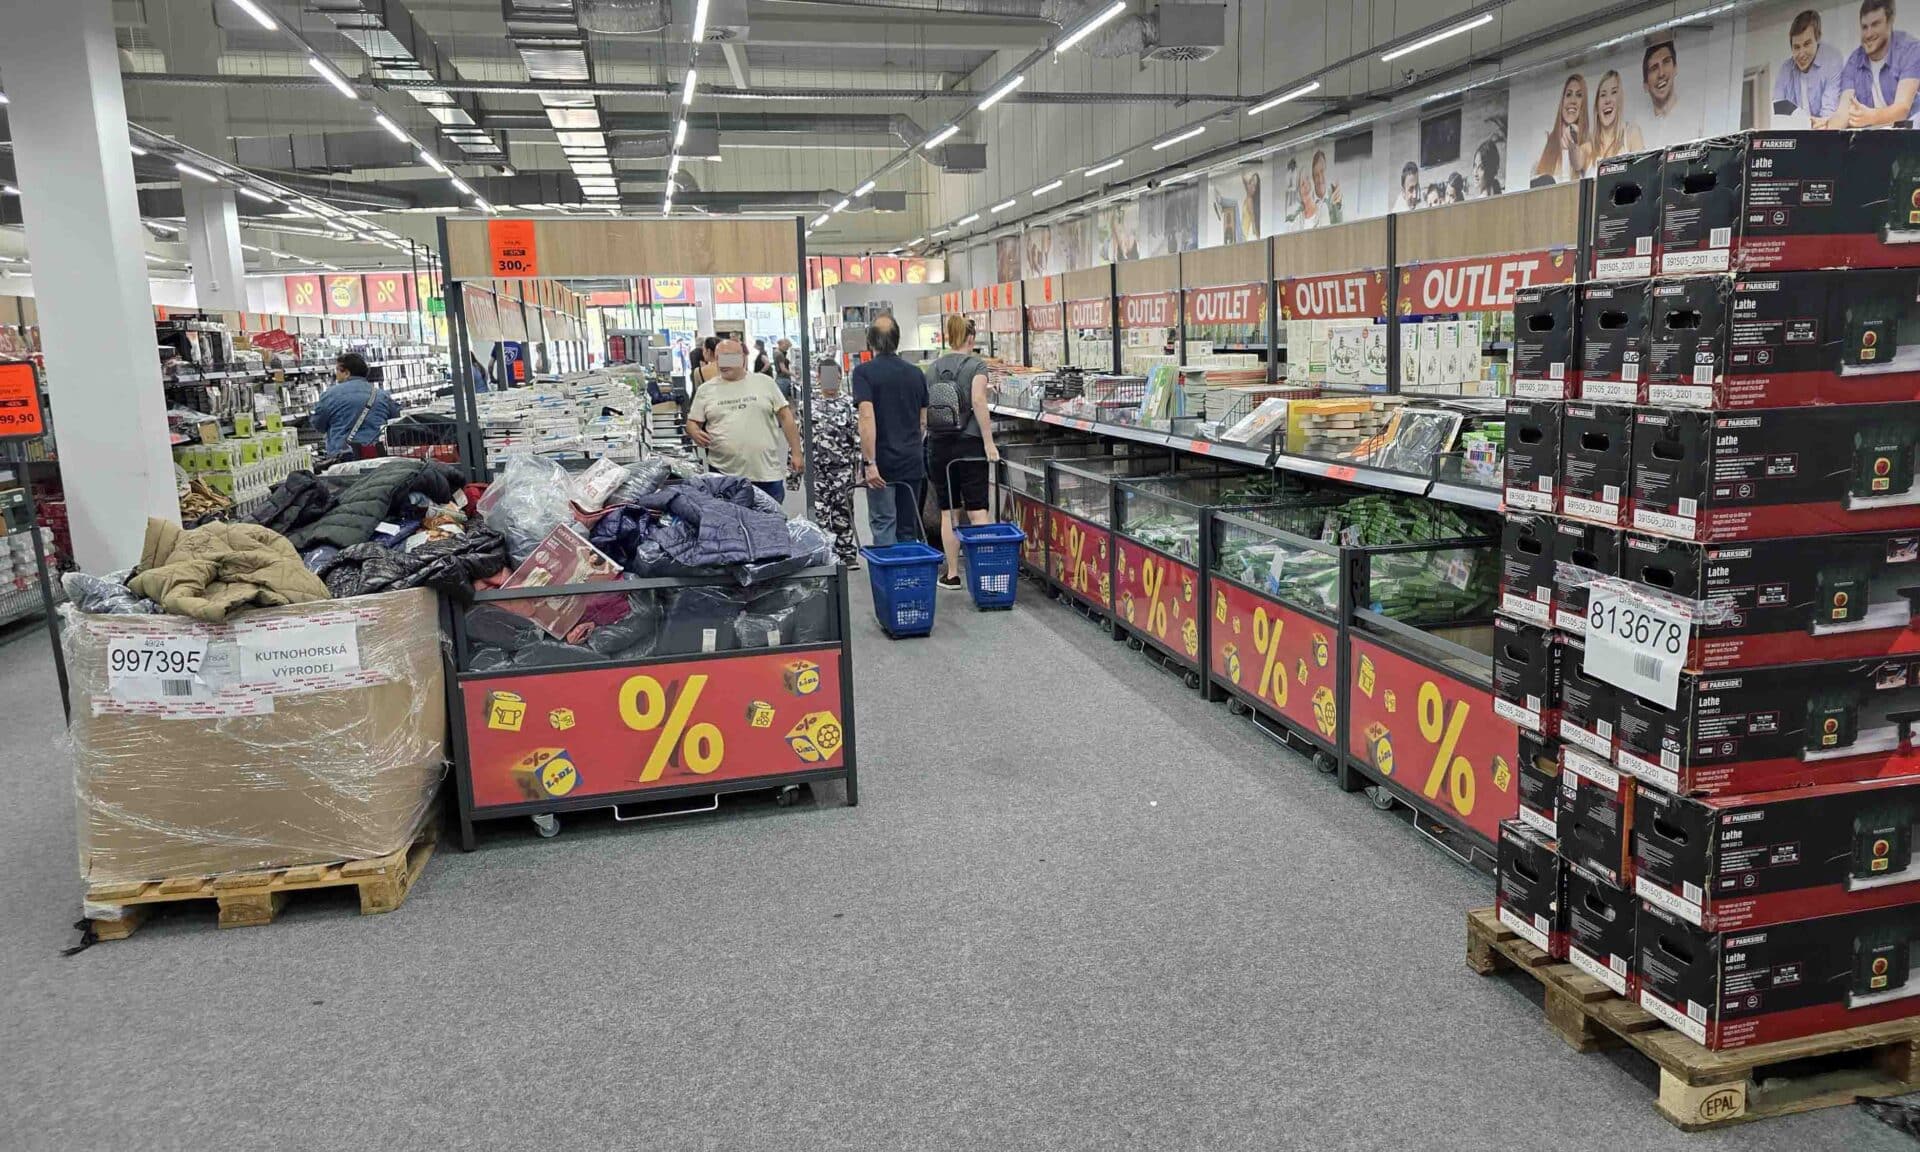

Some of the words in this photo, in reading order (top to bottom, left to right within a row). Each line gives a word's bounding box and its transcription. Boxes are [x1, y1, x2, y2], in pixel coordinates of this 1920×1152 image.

[1762, 140, 1795, 148] PARKSIDE
[1751, 157, 1773, 169] Lathe
[498, 260, 532, 272] 300,-
[1423, 260, 1540, 309] OUTLET
[1745, 282, 1777, 290] PARKSIDE
[1296, 277, 1368, 315] OUTLET
[1127, 297, 1168, 323] OUTLET
[1196, 289, 1250, 321] OUTLET
[1733, 299, 1757, 310] Lathe
[1073, 302, 1104, 327] OUTLET
[1728, 418, 1759, 428] PARKSIDE
[1716, 435, 1738, 447] Lathe
[1718, 550, 1750, 559] PARKSIDE
[1707, 566, 1730, 578] Lathe
[1590, 600, 1682, 654] 813678
[144, 639, 165, 648] 49/24
[255, 644, 348, 662] KUTNOHORSKÁ
[111, 648, 201, 673] 997395
[272, 663, 334, 678] VÝPRODEJ
[1709, 679, 1741, 689] PARKSIDE
[1698, 696, 1720, 707] Lathe
[1732, 812, 1762, 823] PARKSIDE
[1721, 829, 1743, 841] Lathe
[1735, 935, 1764, 946] PARKSIDE
[1725, 952, 1746, 964] Lathe
[1706, 1096, 1735, 1117] EPAL
